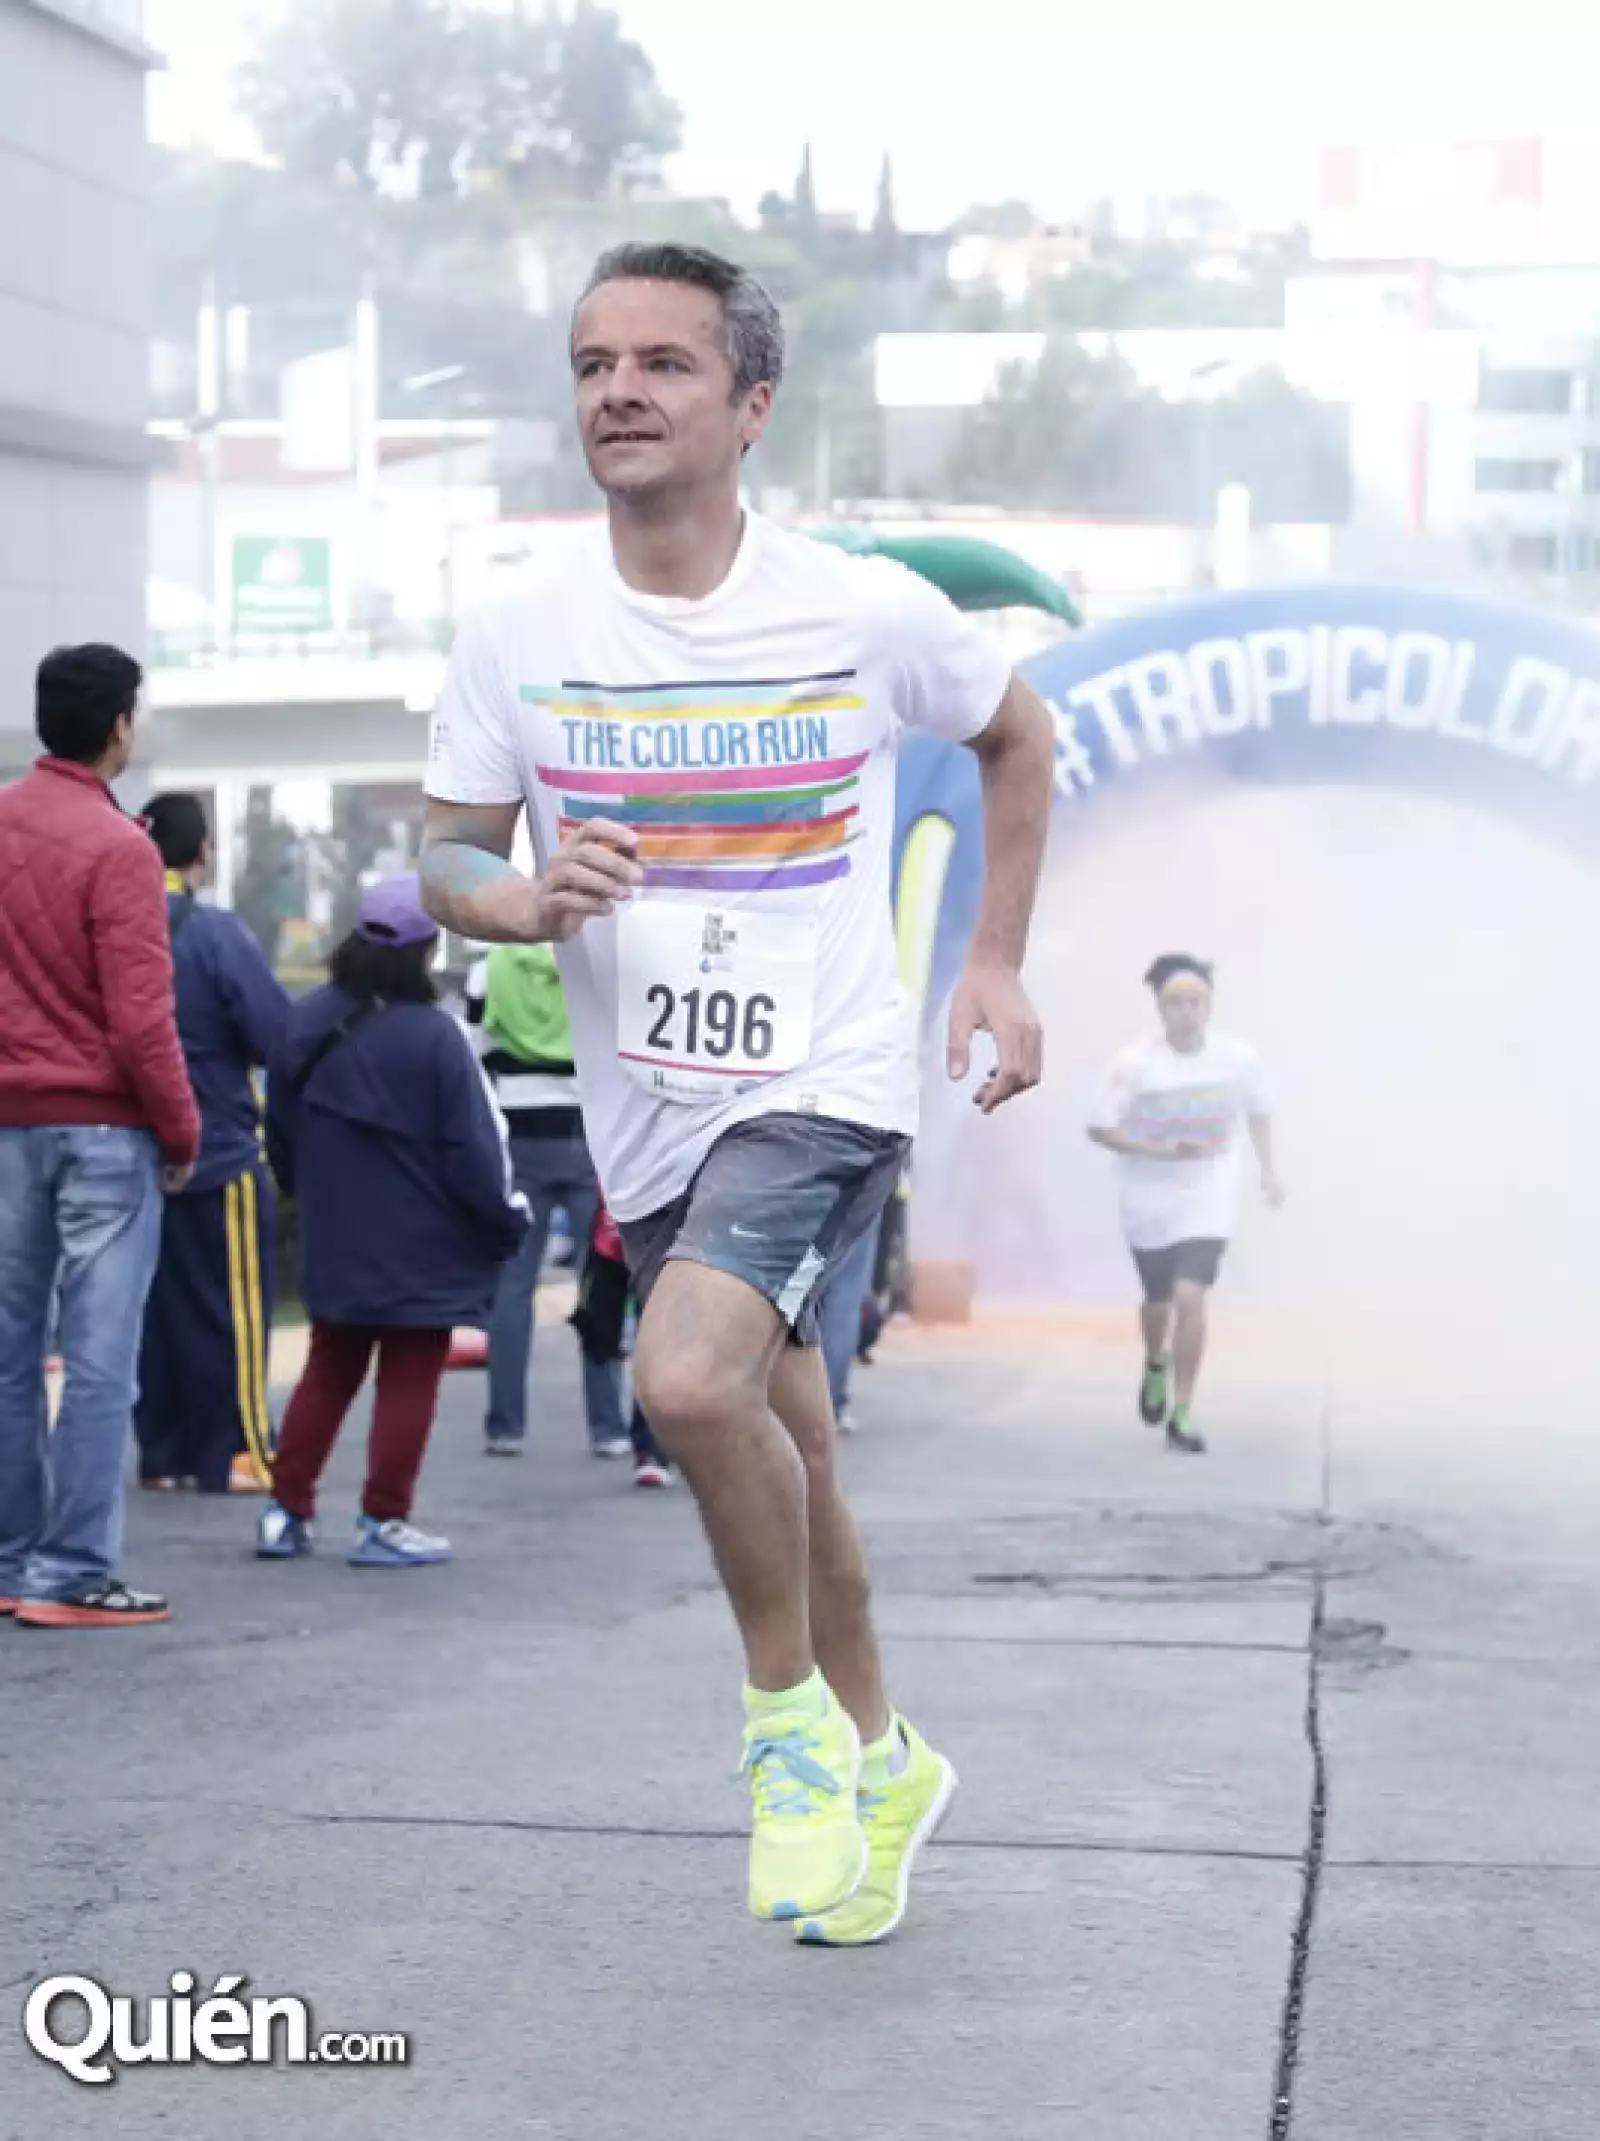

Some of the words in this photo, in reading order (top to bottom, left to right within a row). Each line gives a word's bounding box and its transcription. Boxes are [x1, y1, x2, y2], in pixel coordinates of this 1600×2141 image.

[561, 718, 624, 767] THE
[630, 721, 750, 768] COLOR
[757, 715, 828, 763] RUN
[647, 984, 776, 1060] 2196
